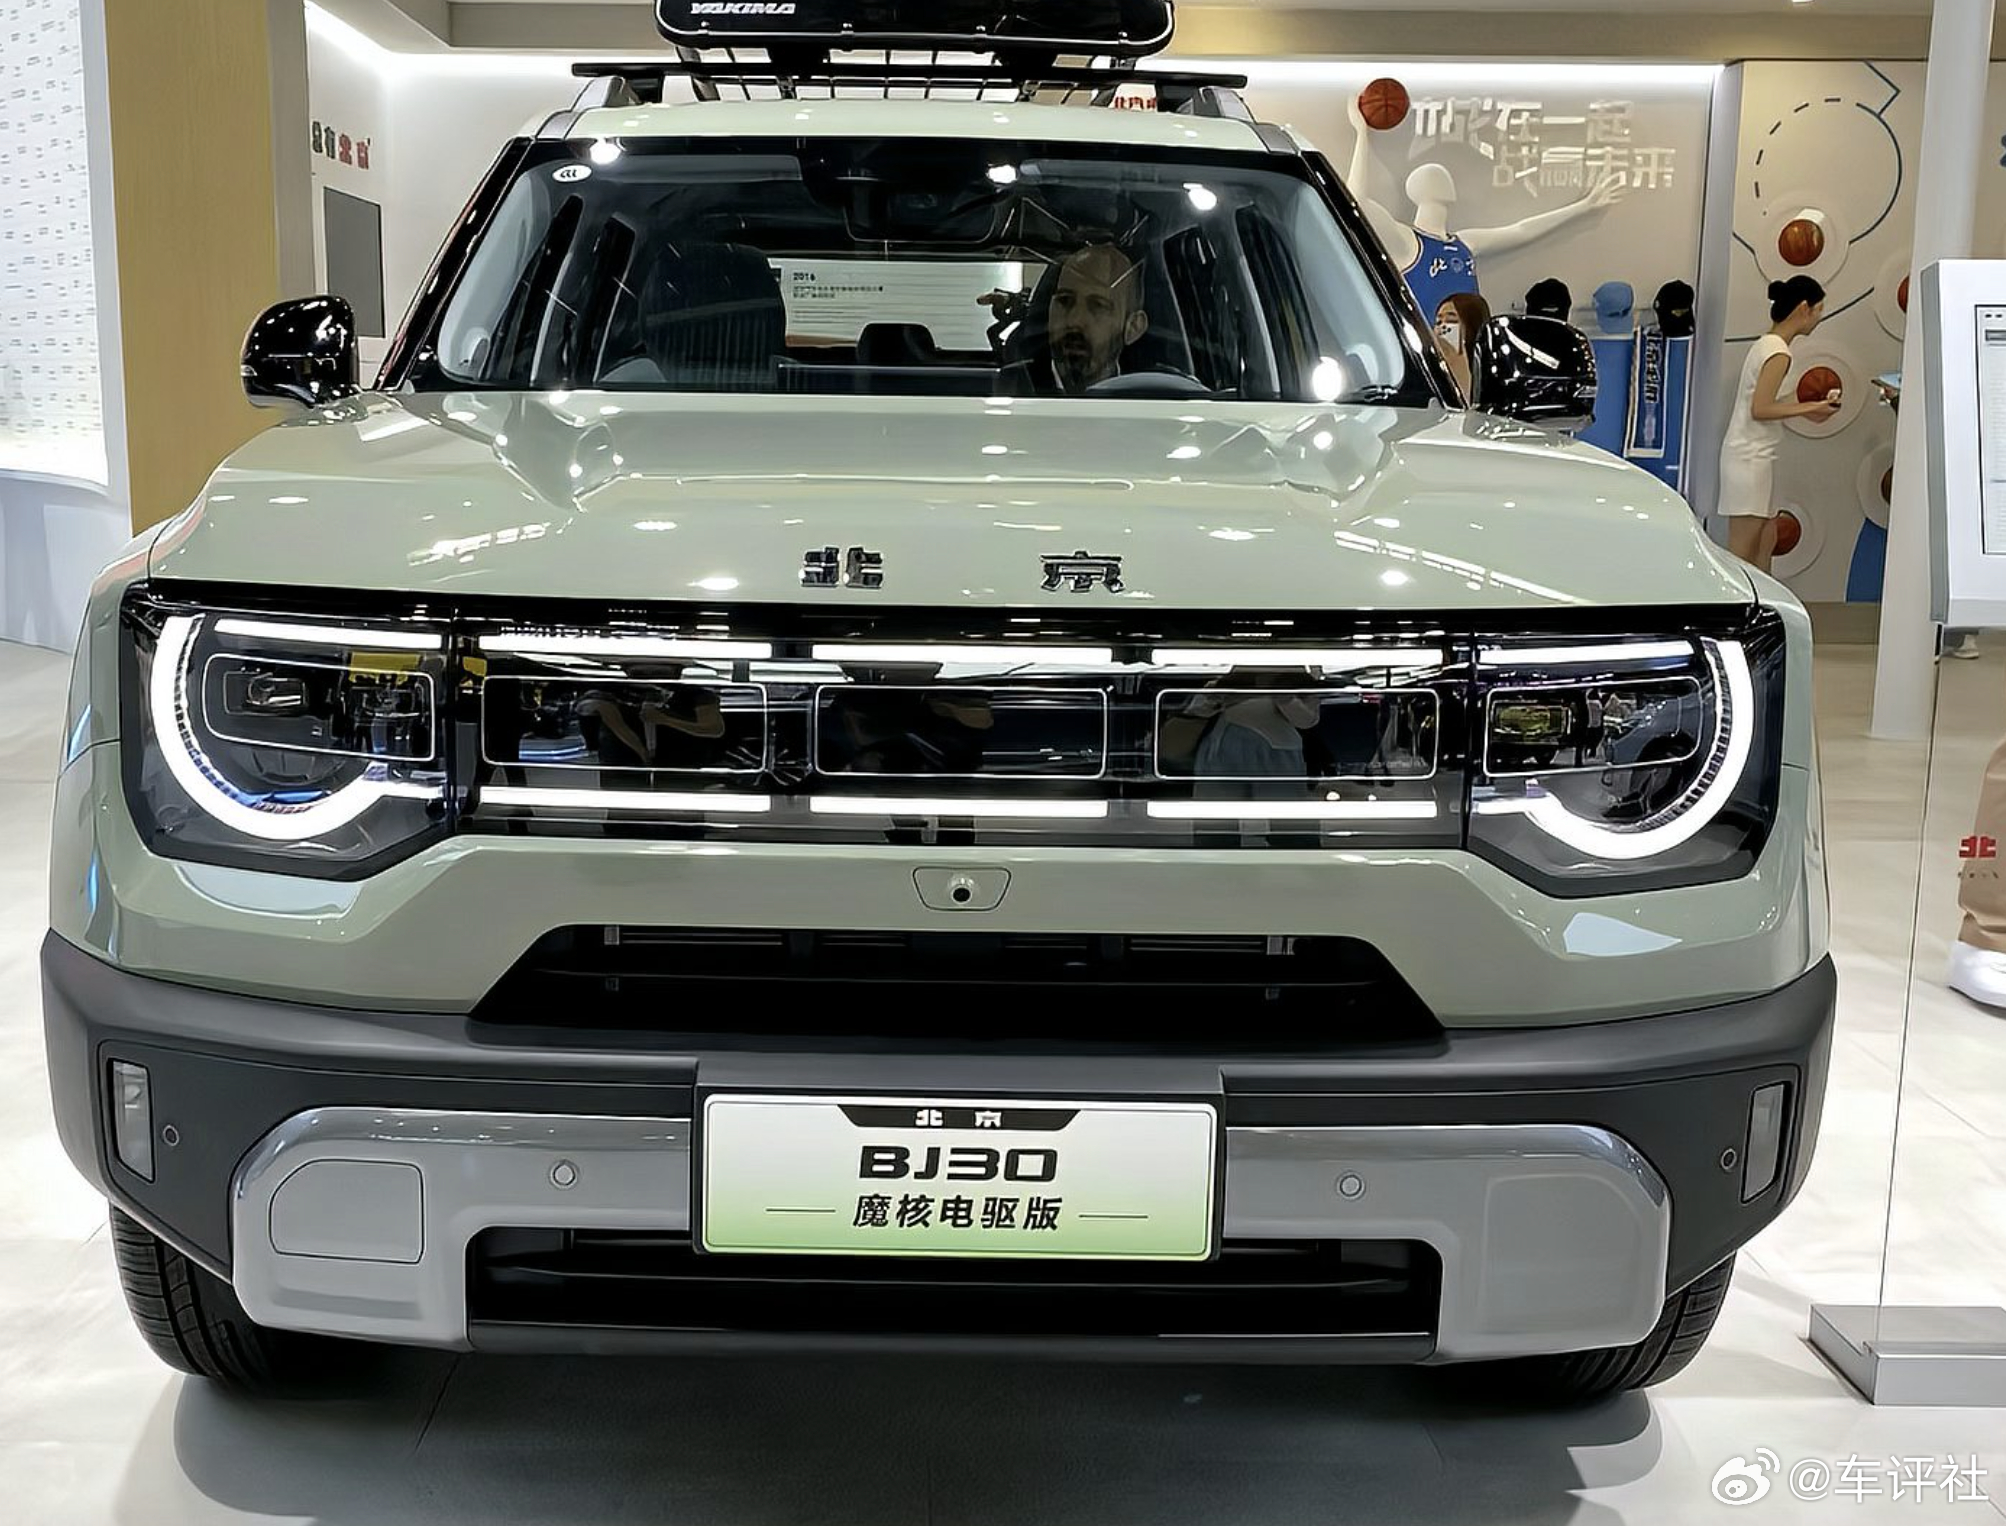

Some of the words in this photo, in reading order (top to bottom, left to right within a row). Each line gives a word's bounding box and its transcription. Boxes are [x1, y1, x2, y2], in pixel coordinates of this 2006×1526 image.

[690, 3, 796, 15] YAKIMA
[914, 1108, 1003, 1129] 北京
[858, 1145, 1058, 1183] BJ30
[852, 1193, 1063, 1231] 魔核电驱版
